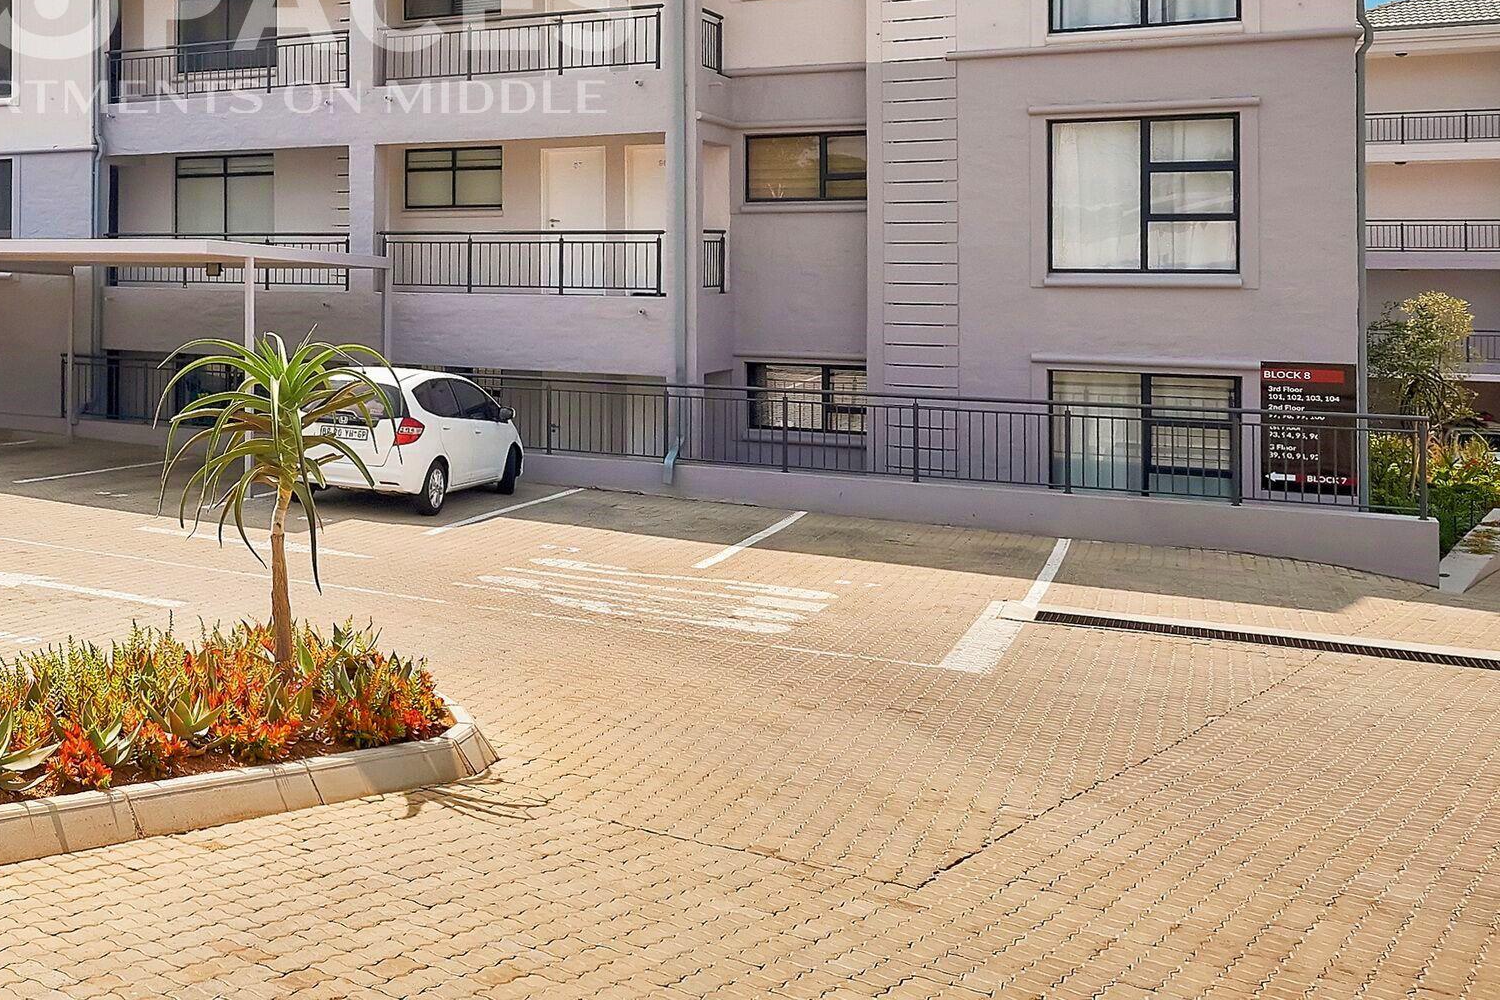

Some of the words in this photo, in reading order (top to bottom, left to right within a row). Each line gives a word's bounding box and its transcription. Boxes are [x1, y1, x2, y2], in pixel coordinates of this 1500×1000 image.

[1264, 371, 1301, 379] BLOCK
[1303, 372, 1311, 380] 8
[1306, 475, 1340, 484] BLOCK
[1341, 477, 1348, 485] 7
